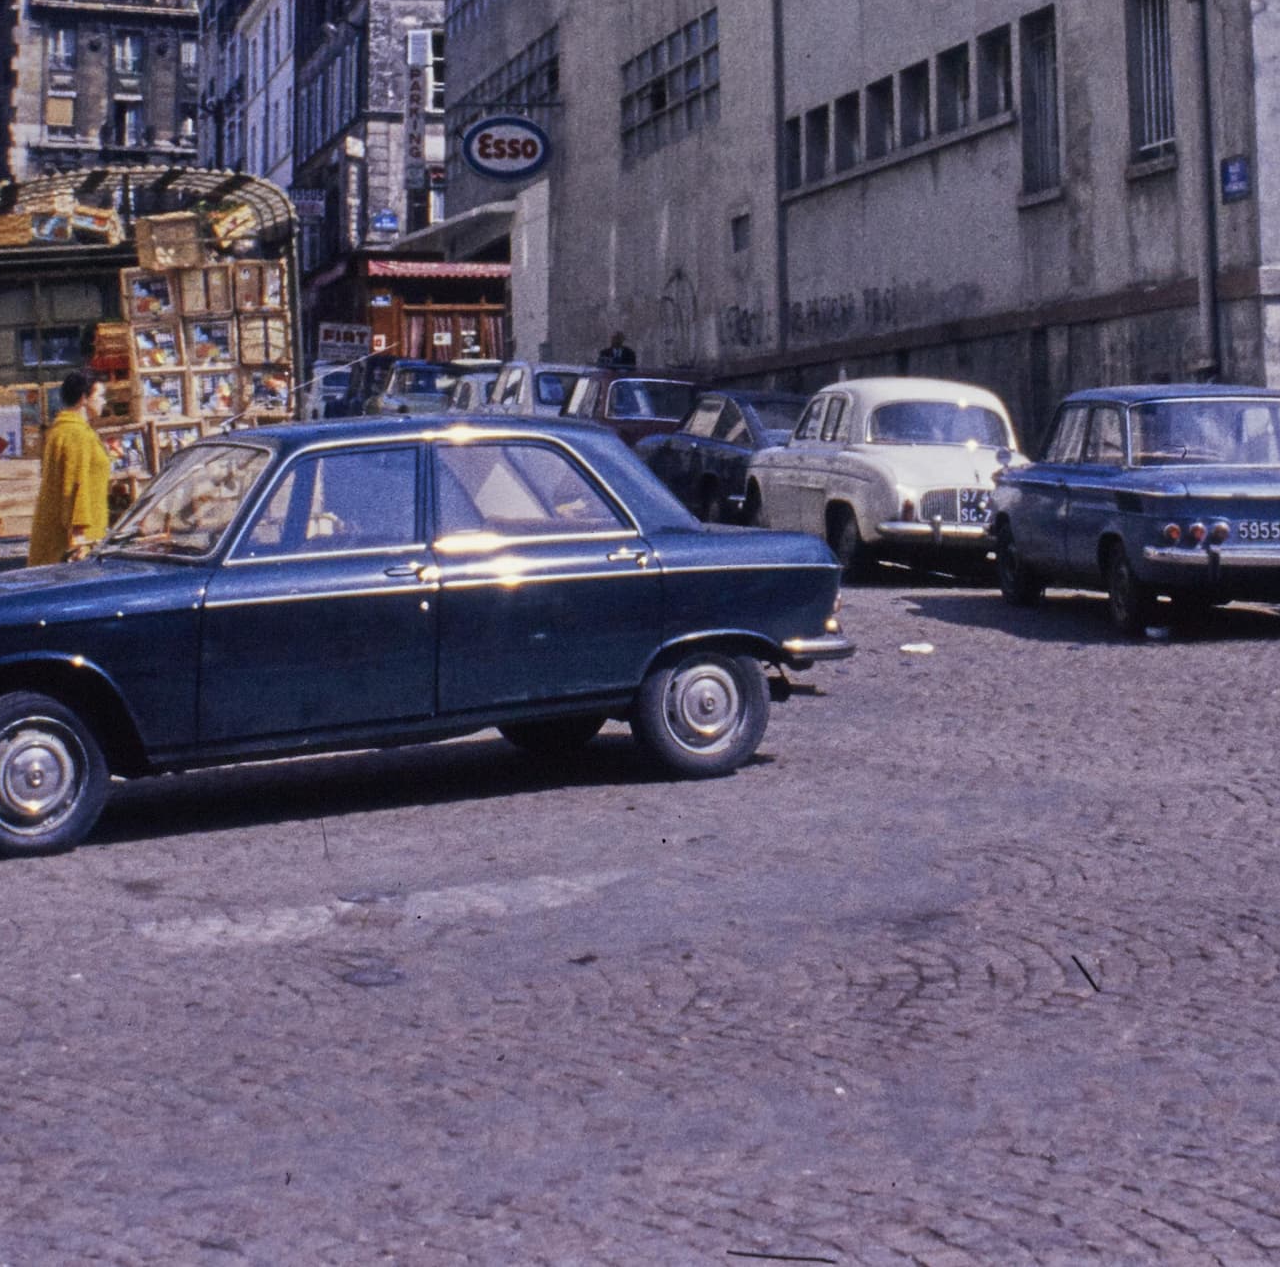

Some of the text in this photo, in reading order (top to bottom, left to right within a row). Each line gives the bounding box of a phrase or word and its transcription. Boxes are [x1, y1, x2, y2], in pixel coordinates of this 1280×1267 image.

[410, 67, 422, 159] PARKING
[322, 329, 370, 344] FIAT
[1239, 521, 1280, 540] 5955
